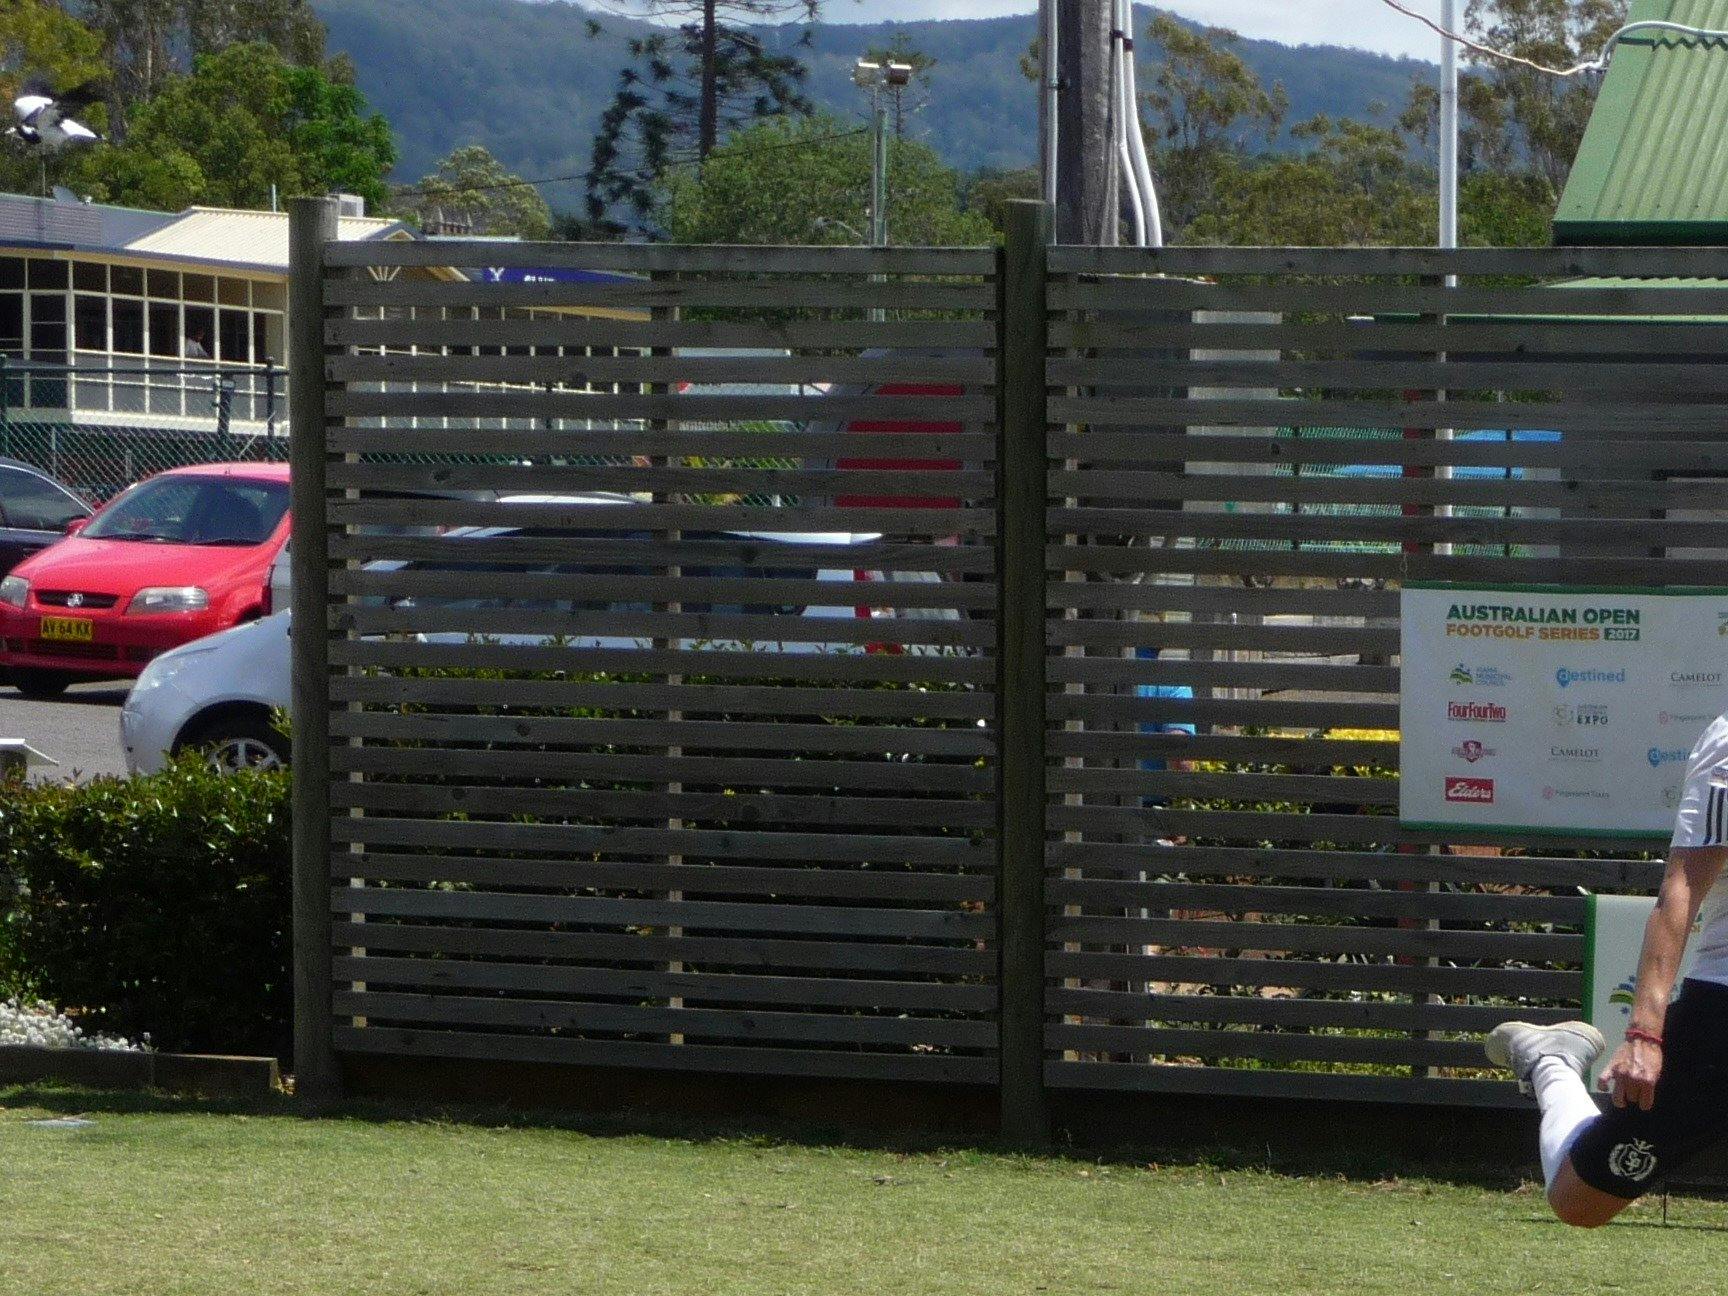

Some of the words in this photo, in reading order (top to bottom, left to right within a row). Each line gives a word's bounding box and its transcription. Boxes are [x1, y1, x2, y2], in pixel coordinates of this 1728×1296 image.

[1446, 604, 1577, 624] AUSTRALIAN
[1582, 608, 1640, 625] OPEN
[1446, 623, 1535, 640] FOOTGOLF
[1538, 626, 1600, 641] SERIES
[1607, 628, 1638, 641] 2017
[1448, 701, 1506, 720] FourFourTwo
[1576, 715, 1609, 725] EXPO
